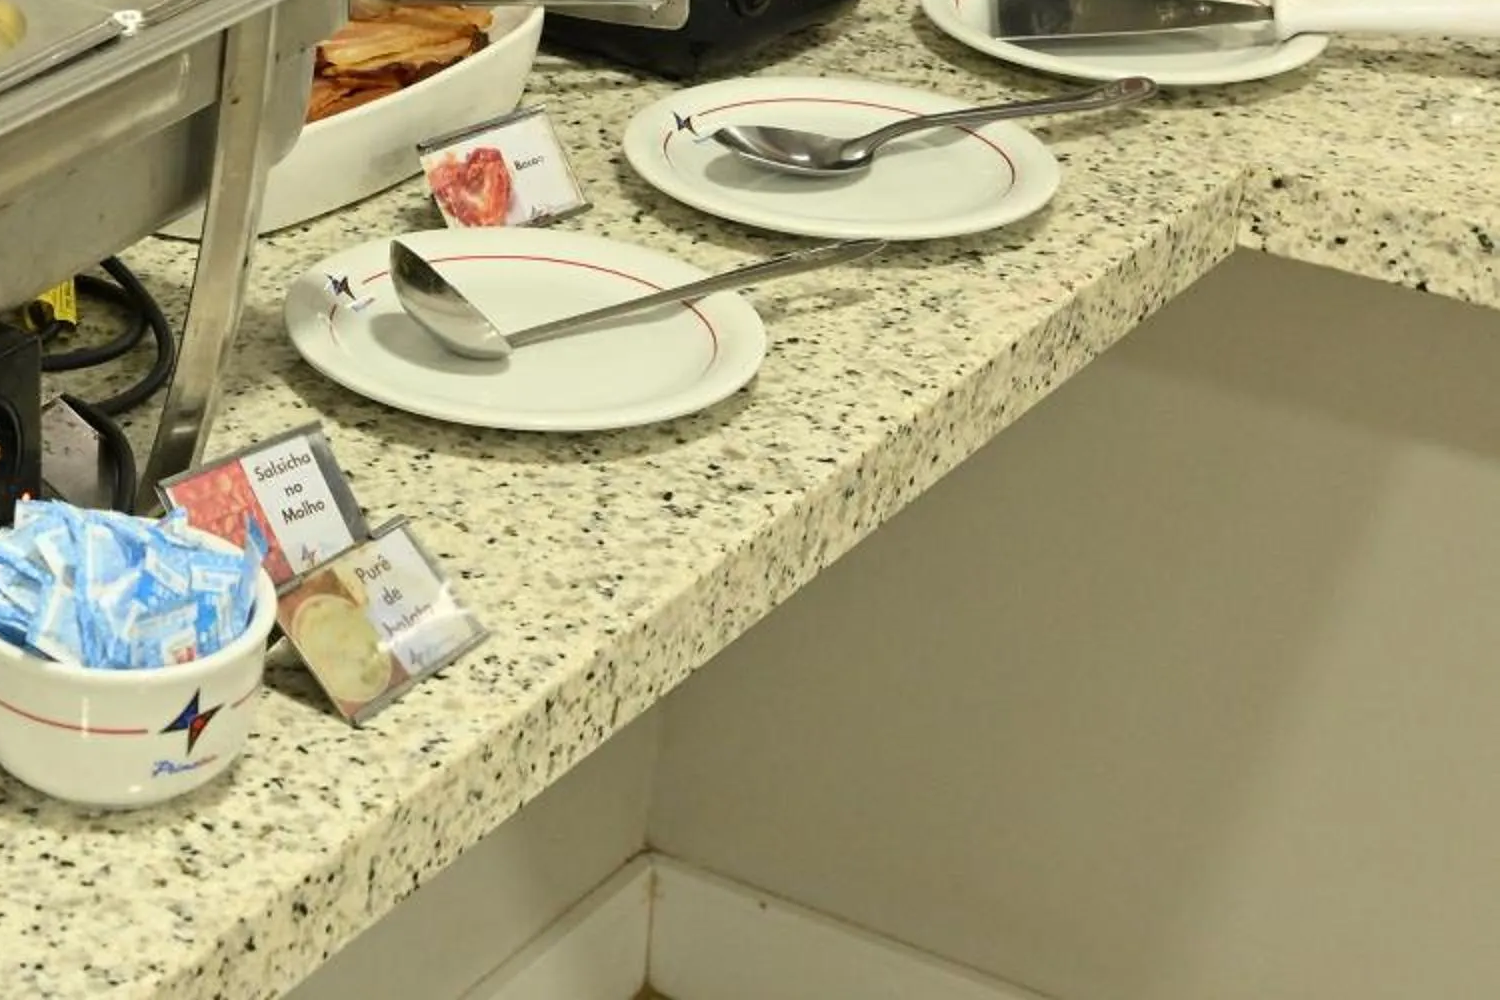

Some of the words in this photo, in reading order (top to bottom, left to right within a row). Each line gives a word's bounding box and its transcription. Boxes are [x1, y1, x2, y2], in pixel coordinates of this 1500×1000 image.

[254, 452, 311, 482] Salsicha
[283, 483, 303, 498] no
[281, 500, 325, 525] Molho
[354, 553, 392, 585] Purê
[381, 586, 403, 606] de
